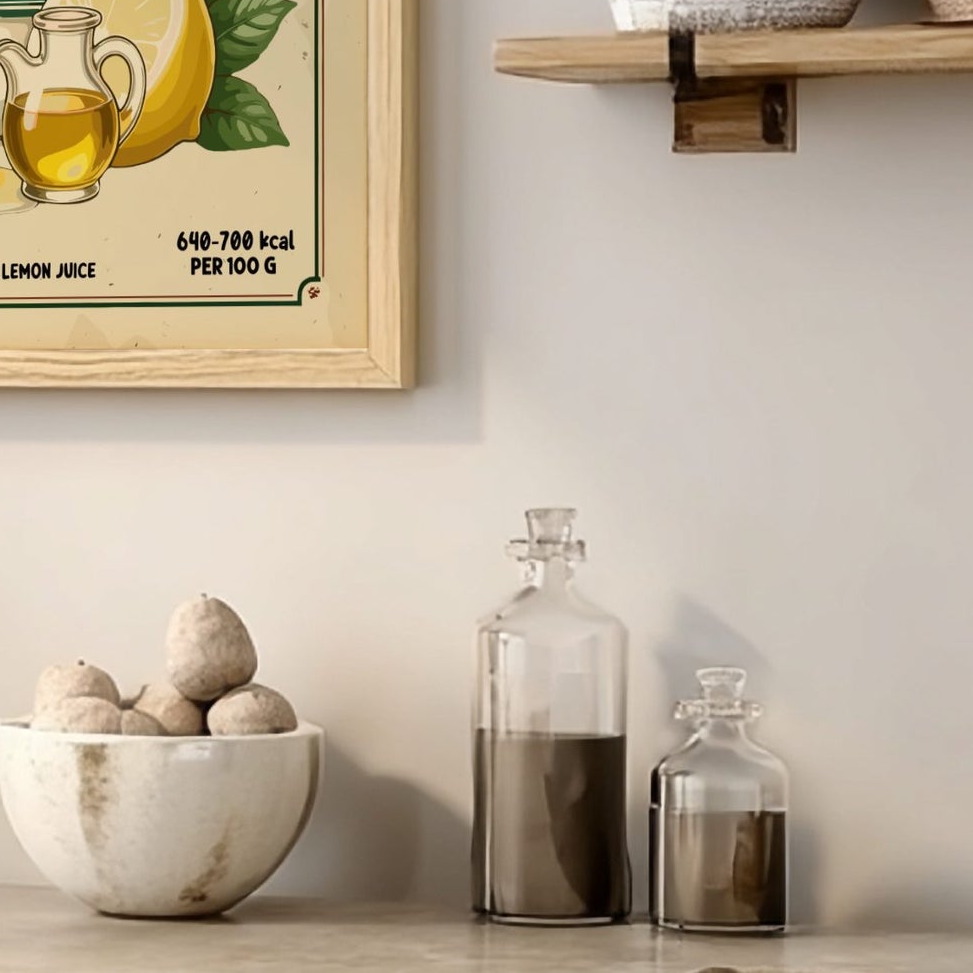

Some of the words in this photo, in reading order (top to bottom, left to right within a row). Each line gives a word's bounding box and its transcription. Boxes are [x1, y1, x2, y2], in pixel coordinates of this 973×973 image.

[177, 230, 254, 252] 640-700
[259, 229, 295, 251] kcal
[2, 262, 51, 280] LEMON
[56, 262, 96, 279] JUICE
[190, 257, 223, 275] PER
[227, 256, 260, 275] 100
[264, 256, 277, 275] G
